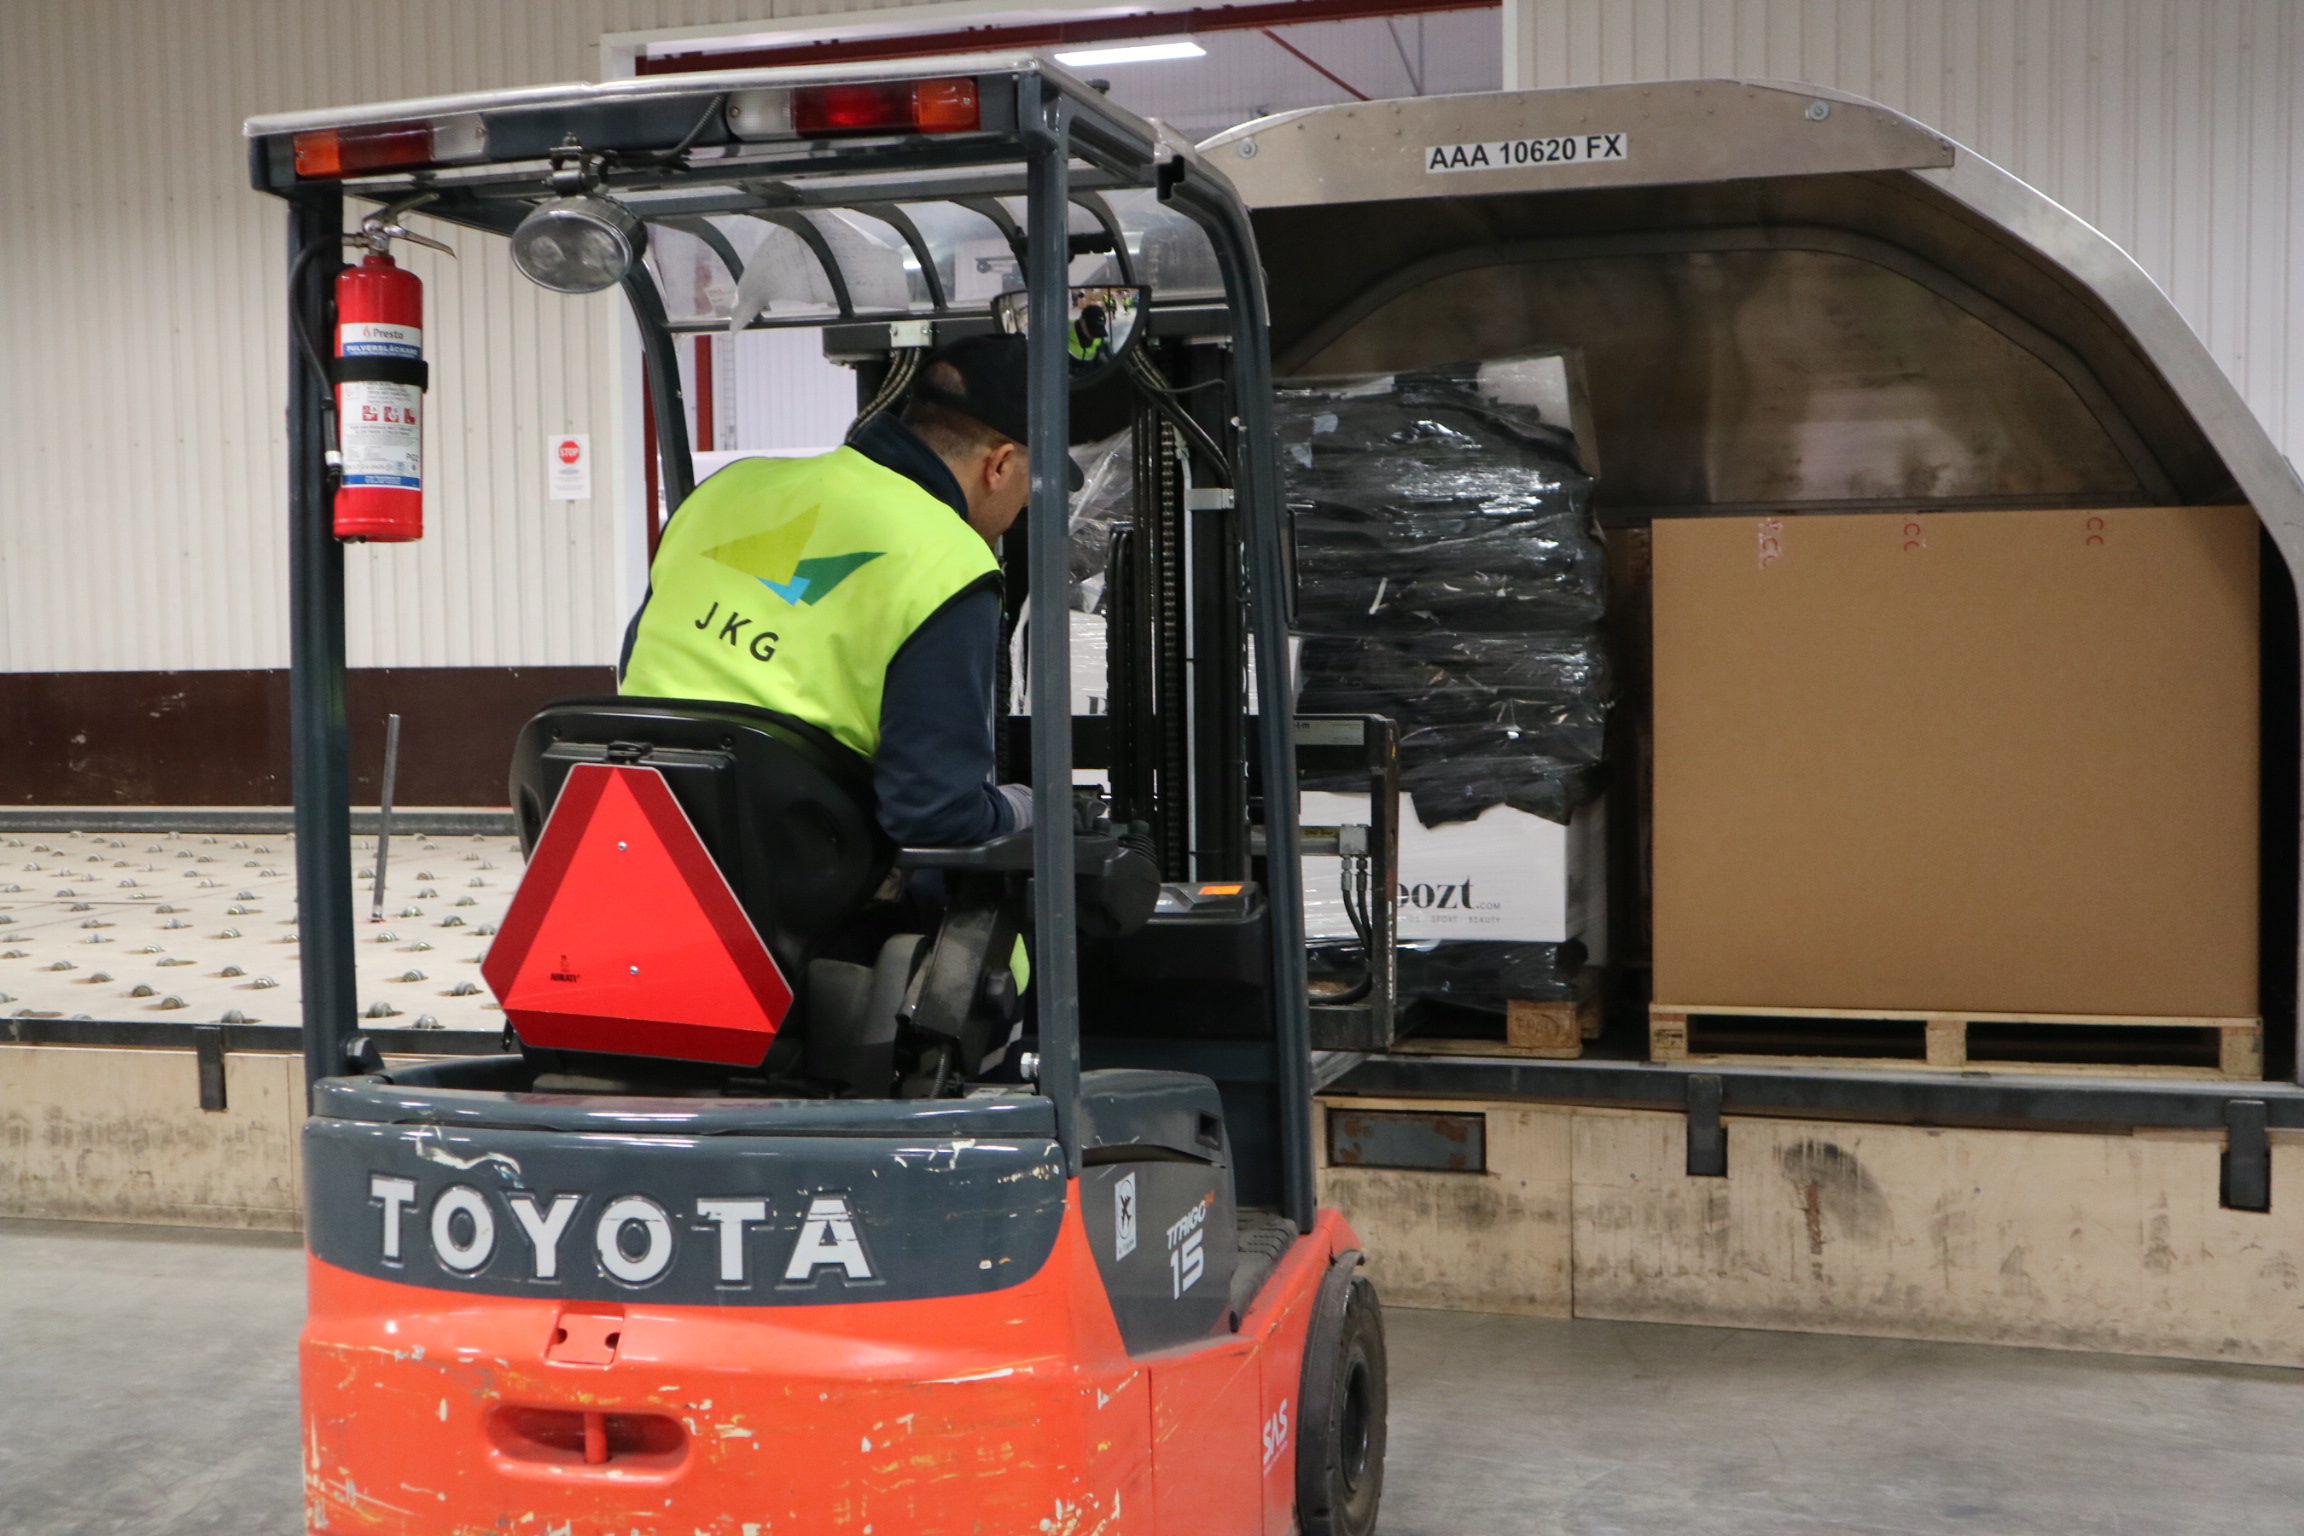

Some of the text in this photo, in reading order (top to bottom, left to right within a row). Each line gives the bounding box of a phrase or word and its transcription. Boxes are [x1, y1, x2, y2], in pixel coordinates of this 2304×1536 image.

[1429, 134, 1622, 170] AAA 10620 FX
[373, 328, 404, 340] Presto
[559, 447, 580, 458] STOP
[694, 601, 780, 663] JKG
[369, 1175, 878, 1286] TOYOTA
[1169, 1228, 1205, 1301] 15
[1262, 1397, 1288, 1465] SAS
